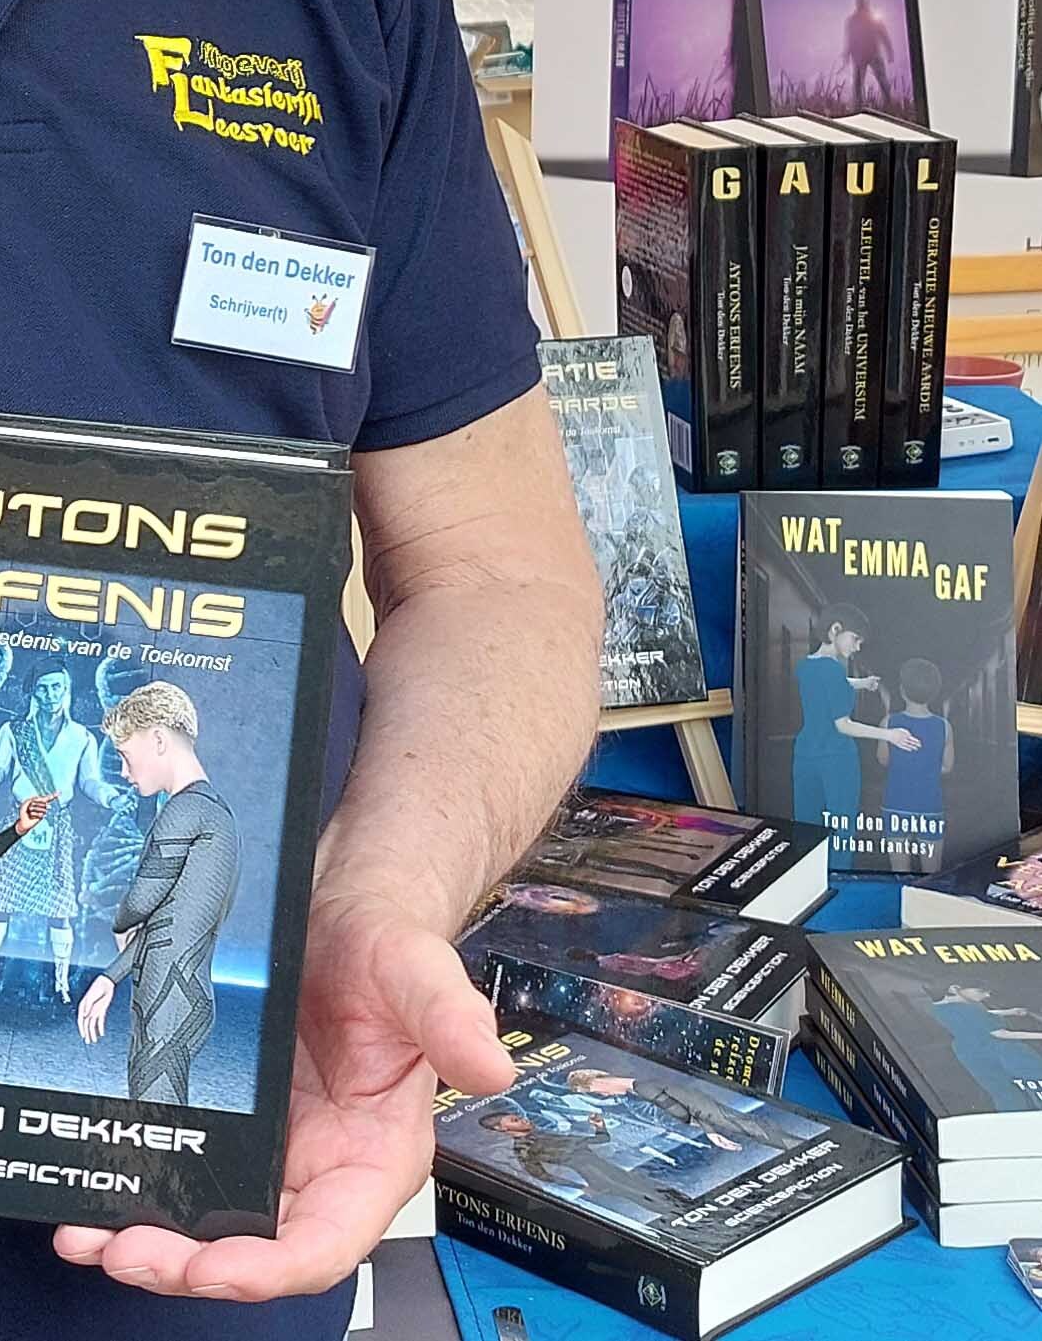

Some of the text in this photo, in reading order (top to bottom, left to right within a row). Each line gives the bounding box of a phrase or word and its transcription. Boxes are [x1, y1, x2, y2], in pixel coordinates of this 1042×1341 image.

[712, 158, 939, 199] G A U L
[201, 242, 356, 289] Ton den Dekker
[793, 244, 808, 282] JACK
[859, 217, 873, 285] SLEUTEL
[209, 294, 288, 324] Schrijver(t)
[795, 286, 808, 295] is
[729, 260, 742, 389] AYTONS ERFENIS
[918, 217, 940, 413] OPERATIE NIEUWE AARDE
[794, 328, 807, 374] NAAM
[854, 332, 868, 422] UNIVERSUM
[781, 516, 988, 602] WAT EMMA GAF
[66, 640, 103, 658] van
[107, 641, 132, 661] de
[139, 644, 232, 673] Toekomst
[599, 651, 669, 670] EKKER
[822, 811, 945, 835] Ton den Dekker
[833, 835, 935, 858] Urban fantasy
[692, 827, 778, 894] TON DEN DEKKER
[703, 973, 733, 996] DEN
[726, 935, 774, 974] DEKKER
[853, 937, 1041, 964] WAT EMMA
[17, 1109, 207, 1156] DEKKER
[671, 1140, 840, 1227] TON DEN DEKKER
[724, 1163, 844, 1227] SCIENCEFICTION
[436, 1182, 567, 1252] YTONS ERFENIS
[456, 1211, 534, 1255] Ton den Dekker
